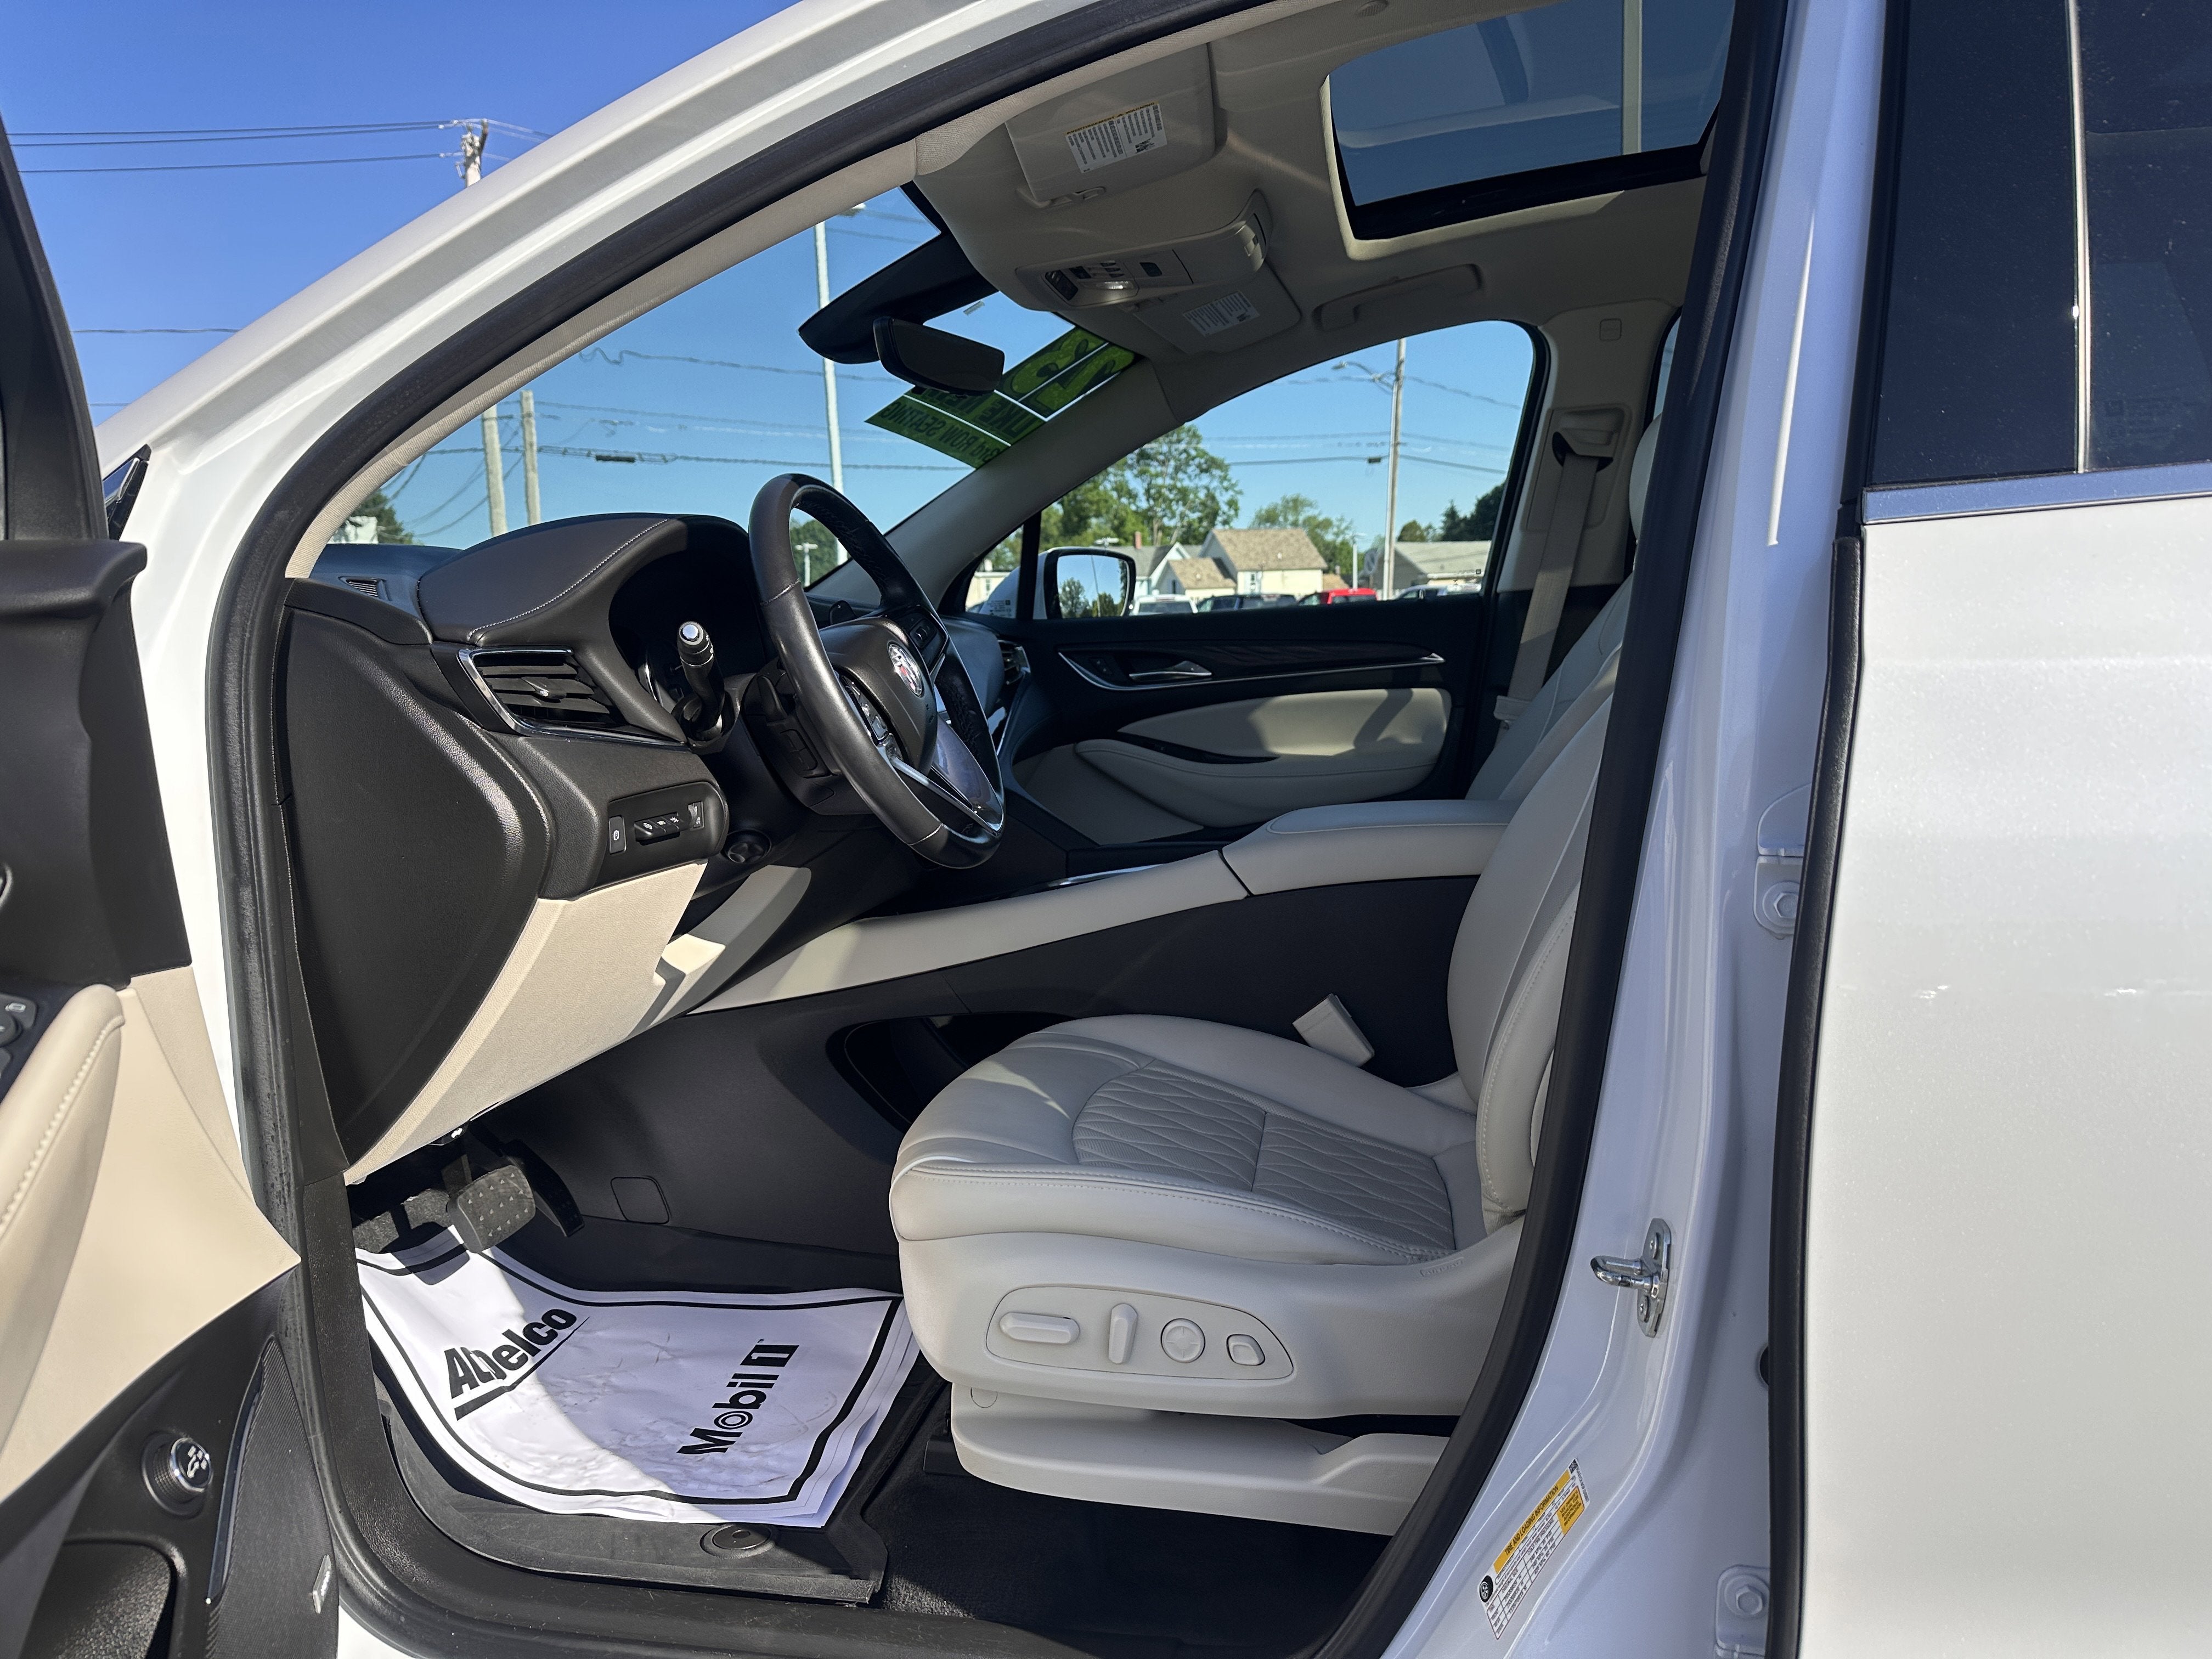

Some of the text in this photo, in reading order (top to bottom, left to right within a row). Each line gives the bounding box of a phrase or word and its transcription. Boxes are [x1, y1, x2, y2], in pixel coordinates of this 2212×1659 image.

[676, 1373, 780, 1455] Mobil
[1504, 1542, 1513, 1556] TIRE
[1512, 1531, 1521, 1547] AND
[1520, 1513, 1535, 1537] LOADING
[1535, 1485, 1559, 1519] INFORMATION
